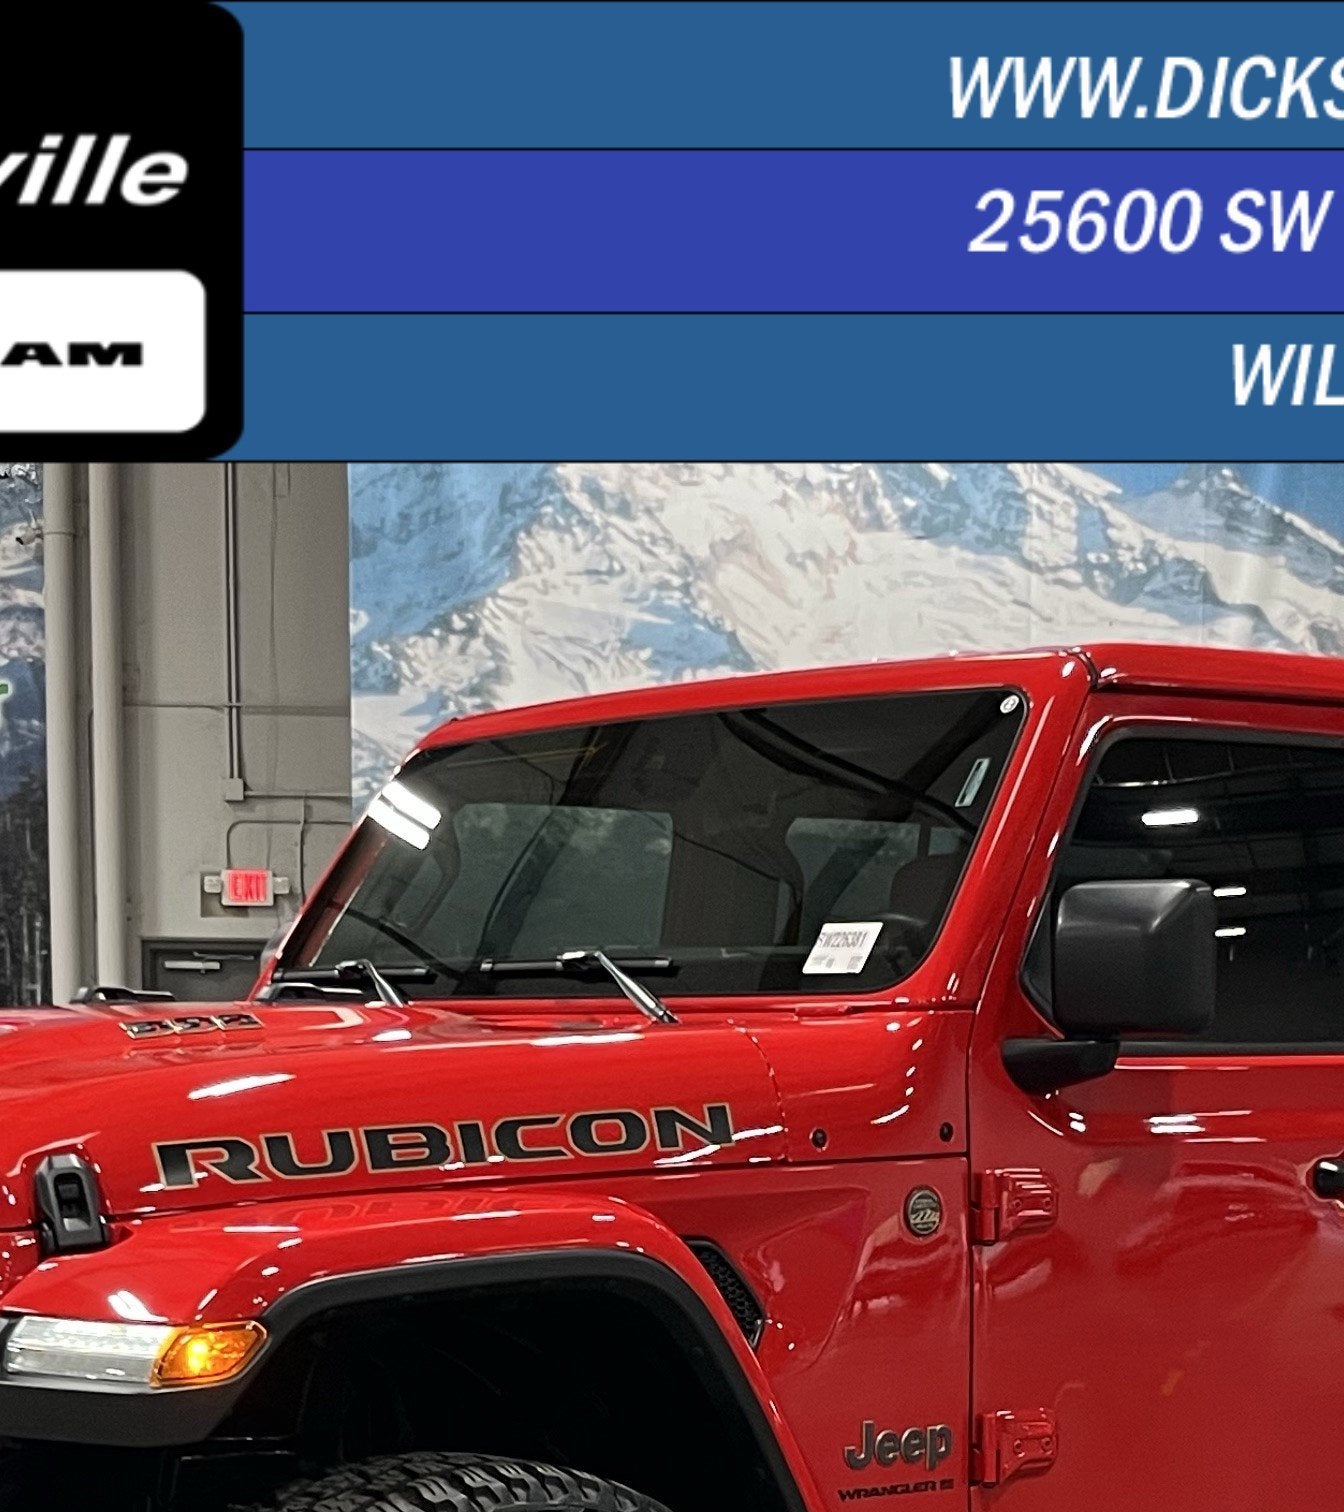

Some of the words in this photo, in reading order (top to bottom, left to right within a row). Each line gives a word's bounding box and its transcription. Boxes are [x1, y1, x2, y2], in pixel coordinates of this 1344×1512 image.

[229, 873, 267, 901] EXIT
[152, 1102, 736, 1187] RUBICON
[843, 1419, 953, 1471] Jeep
[837, 1480, 937, 1501] WRANGLER
